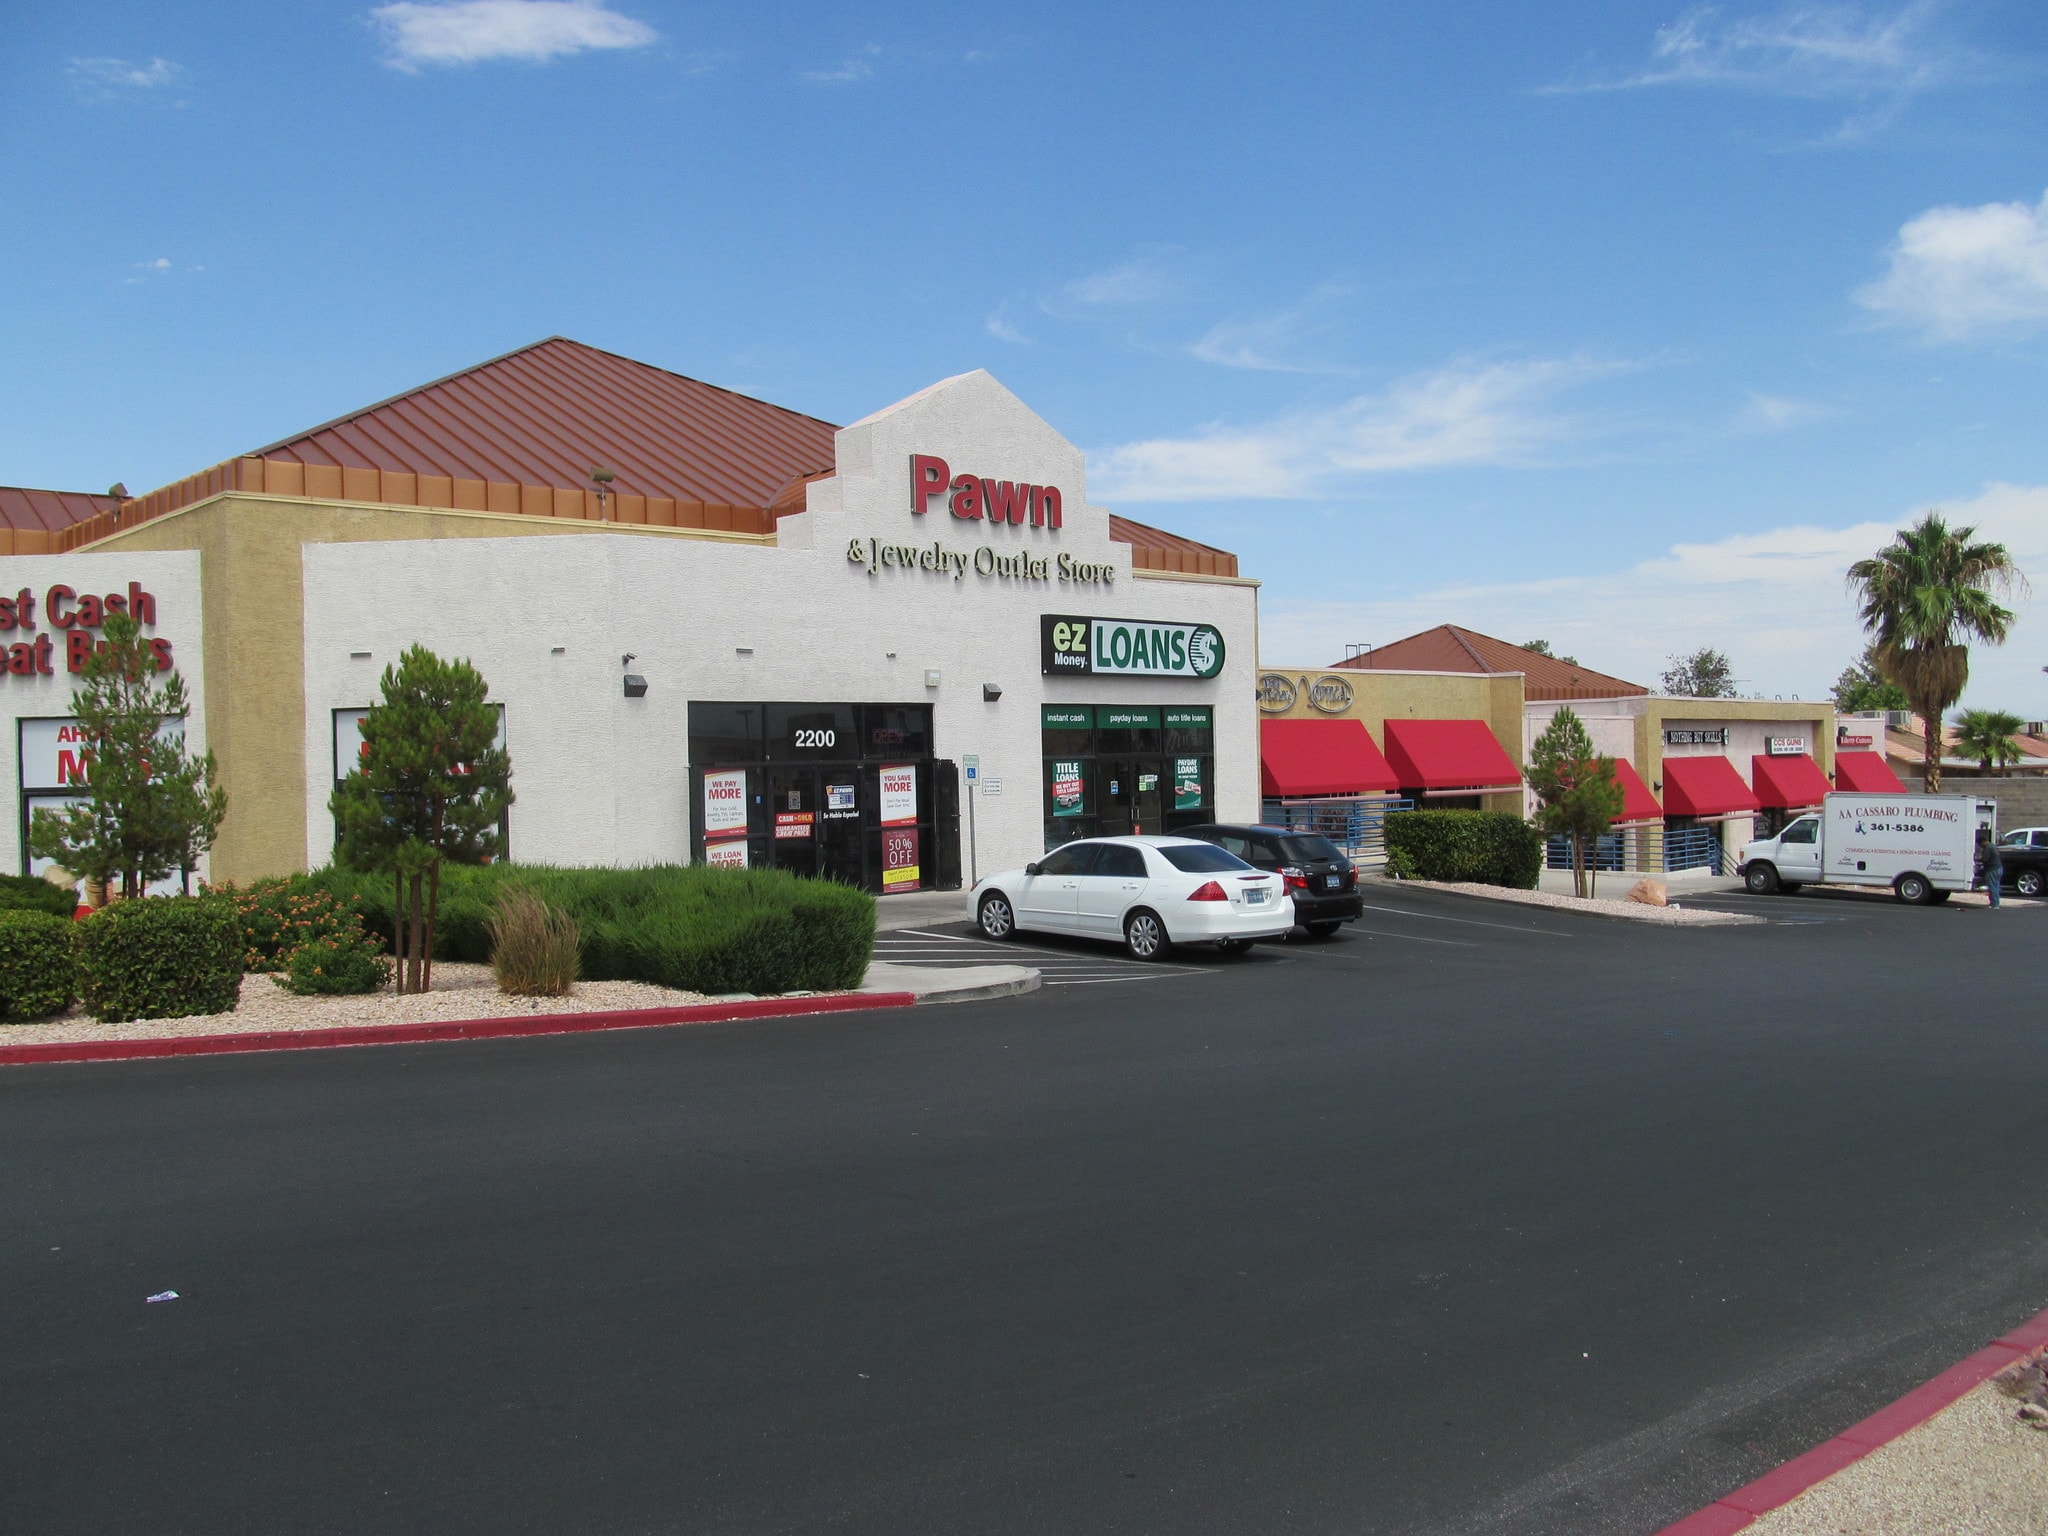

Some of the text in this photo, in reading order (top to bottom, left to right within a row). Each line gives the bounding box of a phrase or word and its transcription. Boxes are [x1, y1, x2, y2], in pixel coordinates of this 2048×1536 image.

[909, 454, 1062, 529] Pawn
[847, 537, 1115, 582] & Jewelry Outlet Store
[46, 582, 157, 629] Cash
[1053, 622, 1087, 652] ez
[1096, 626, 1186, 670] LOANS
[66, 630, 174, 682] Bs
[1313, 685, 1351, 701] OPTICAL
[1047, 713, 1069, 721] instant
[1110, 714, 1131, 723] payday
[1180, 713, 1191, 721] title
[1192, 713, 1206, 721] loans
[795, 730, 836, 747] 2200
[1670, 731, 1721, 743] NOTHING BUT SKULLS
[1773, 738, 1802, 746] CCS GUNS
[1056, 762, 1079, 773] TITLE
[1177, 766, 1198, 774] LOANS
[1056, 773, 1079, 782] LOANS
[712, 780, 723, 788] WE
[884, 782, 912, 793] MORE
[708, 788, 742, 800] MORE
[1839, 807, 1958, 823] AA CASSARO PLUMBING
[1870, 823, 1924, 832] 361-5386
[889, 838, 912, 851] 50%
[723, 850, 742, 858] LOAN
[889, 850, 912, 865] OFF
